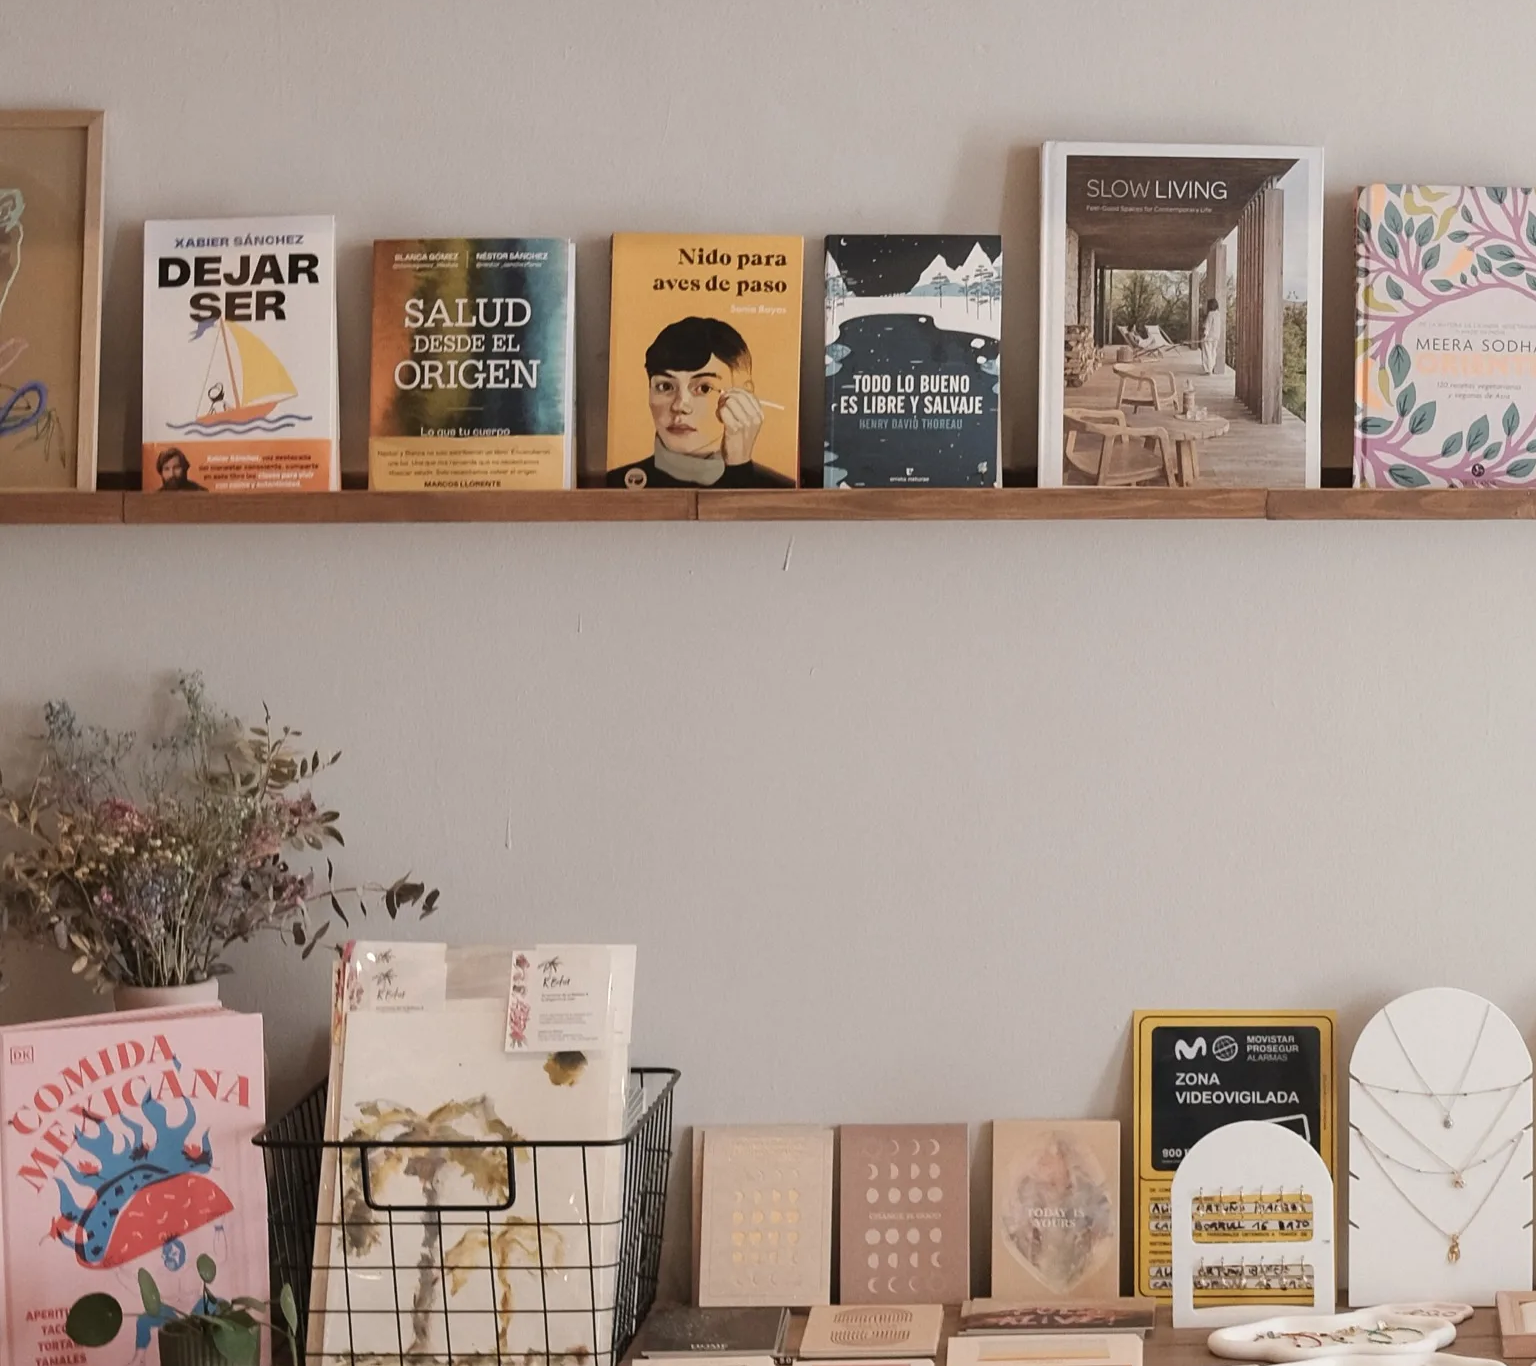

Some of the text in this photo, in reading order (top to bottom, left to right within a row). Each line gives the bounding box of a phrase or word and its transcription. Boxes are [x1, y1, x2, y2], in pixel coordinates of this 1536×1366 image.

[1086, 179, 1227, 199] SLOW LIVING
[394, 251, 459, 262] BLANCA GÓMEZ
[677, 247, 788, 272] Nido para
[158, 253, 319, 288] DEJAR
[652, 274, 788, 297] aves de paso
[189, 290, 286, 321] SER
[404, 297, 532, 329] SALUD
[413, 334, 520, 353] DESDE EL
[1416, 338, 1473, 351] MEERA
[394, 359, 541, 390] ORIGEN
[853, 374, 970, 393] TODO LO BUENO
[840, 395, 984, 414] ES LIBRE Y SALVAJE
[859, 418, 963, 430] HENRY DAVID THOREAU
[460, 480, 501, 488] LLORENTE
[1246, 1035, 1295, 1044] MOVISTAR
[12, 1049, 33, 1061] DK
[1246, 1044, 1299, 1053] PROSEGUR
[7, 1034, 176, 1135] COMIDA
[1175, 1072, 1221, 1085] ZONA
[1175, 1091, 1300, 1104] VIDEOVIGILADA
[16, 1068, 251, 1194] MEXICANA
[1162, 1148, 1182, 1158] 900
[1027, 1207, 1085, 1218] TODAY IS
[1033, 1218, 1077, 1228] YOURS
